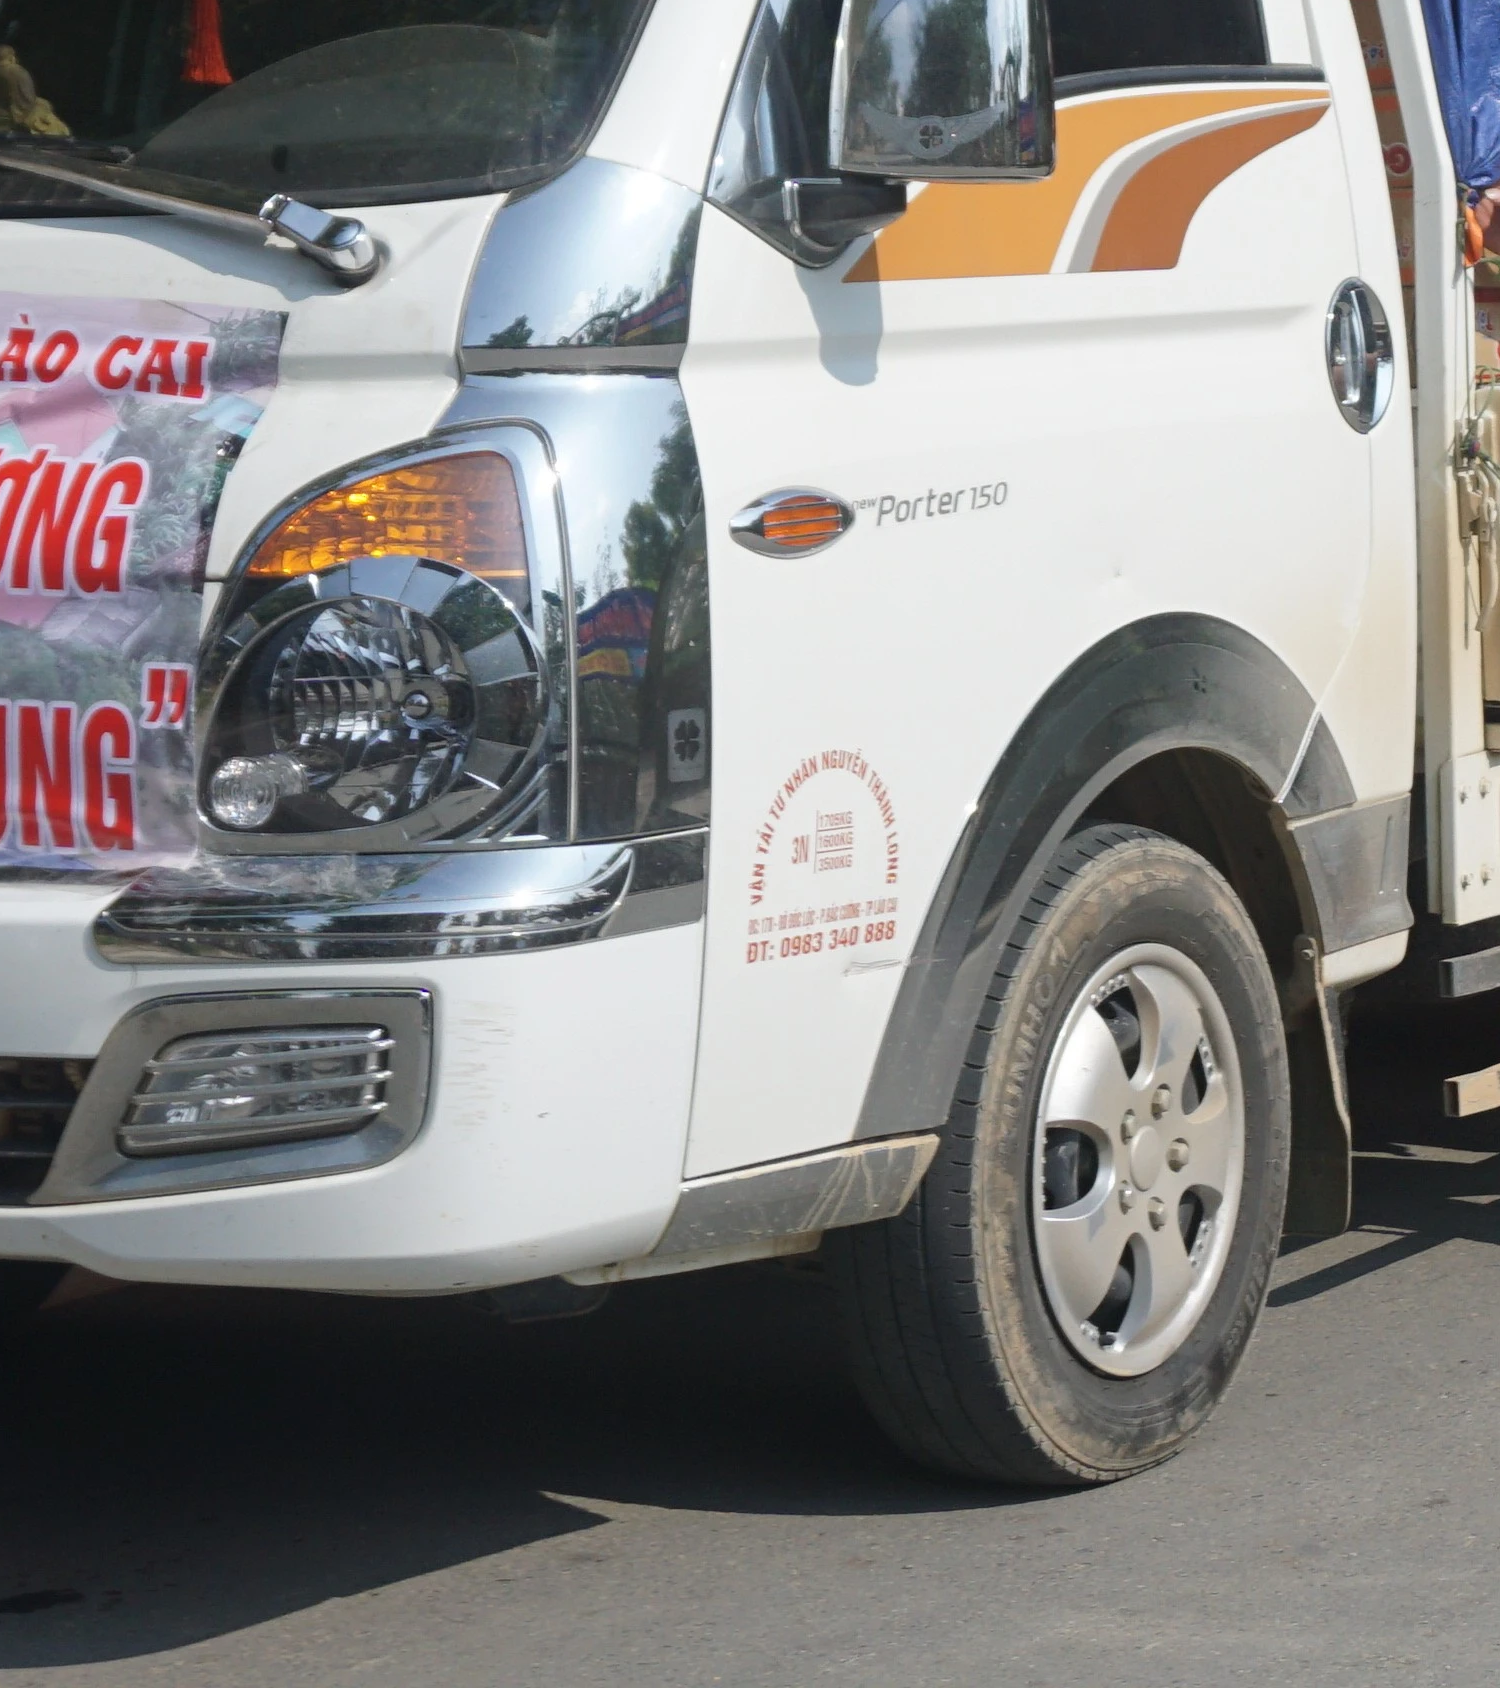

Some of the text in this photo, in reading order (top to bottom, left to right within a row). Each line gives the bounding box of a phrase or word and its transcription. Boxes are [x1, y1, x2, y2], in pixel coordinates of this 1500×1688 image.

[94, 334, 209, 400] CAI
[877, 489, 965, 526] Porter
[970, 481, 1008, 510] 150
[746, 920, 897, 964] ĐT: 0983 340 888
